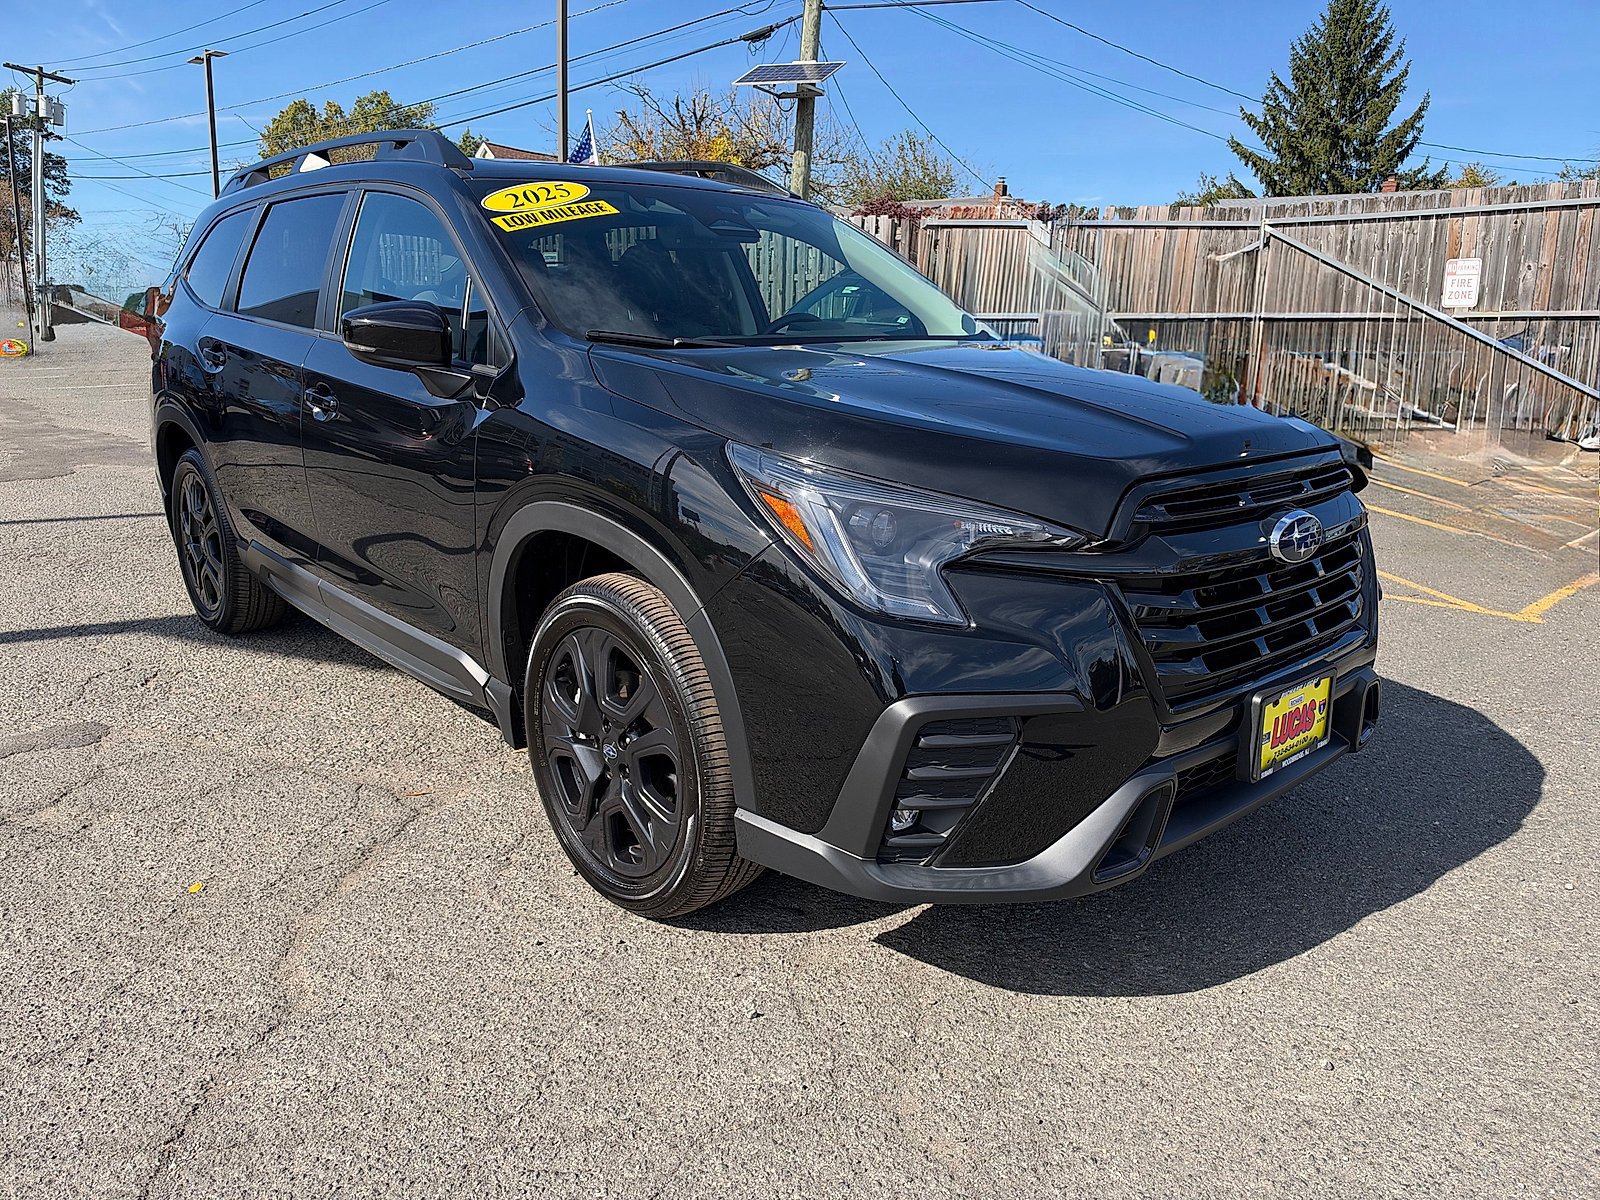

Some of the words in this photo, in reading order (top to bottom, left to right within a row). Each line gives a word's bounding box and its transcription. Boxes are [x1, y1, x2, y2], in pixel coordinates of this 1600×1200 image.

[505, 184, 570, 208] 2025
[501, 212, 540, 228] LOW
[540, 202, 607, 221] MILEAGE
[1447, 263, 1457, 273] NO
[1451, 279, 1473, 288] FIRE
[1447, 290, 1474, 300] ZONE
[1270, 699, 1316, 750] LUCAS
